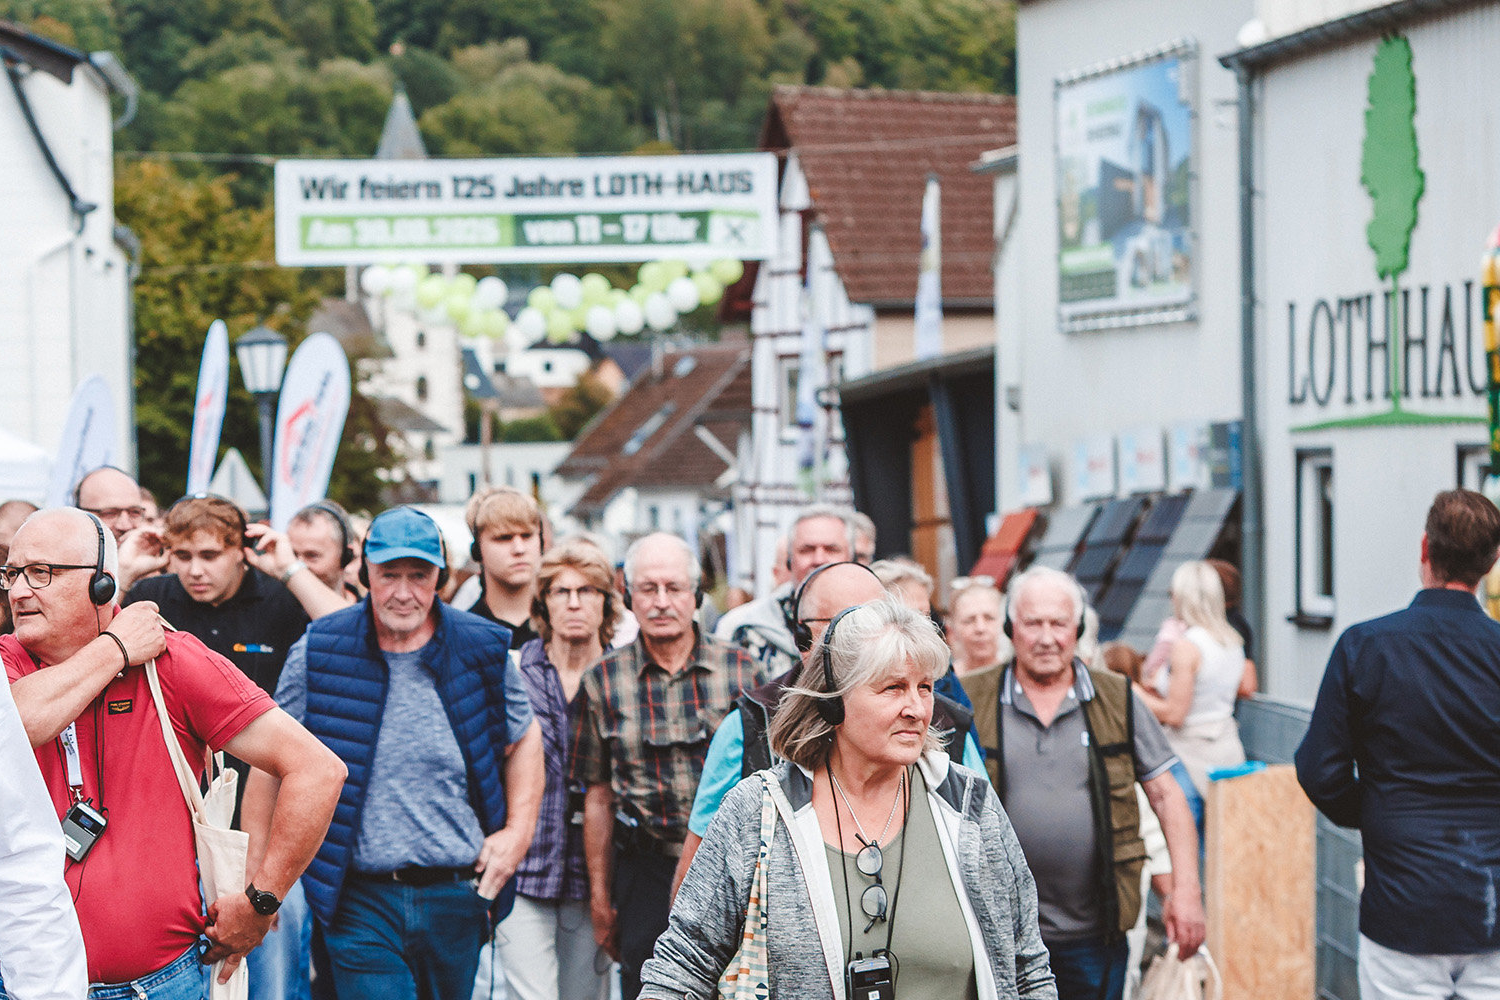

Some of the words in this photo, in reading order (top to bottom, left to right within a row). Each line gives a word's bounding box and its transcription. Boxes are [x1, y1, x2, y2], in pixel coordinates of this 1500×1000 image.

[300, 174, 348, 200] Wir
[359, 174, 441, 199] feiern
[453, 174, 495, 199] 125
[505, 173, 585, 198] Jahre
[593, 169, 754, 197] LOTH-HAUS
[522, 219, 576, 245] von
[651, 212, 700, 243] Uhr
